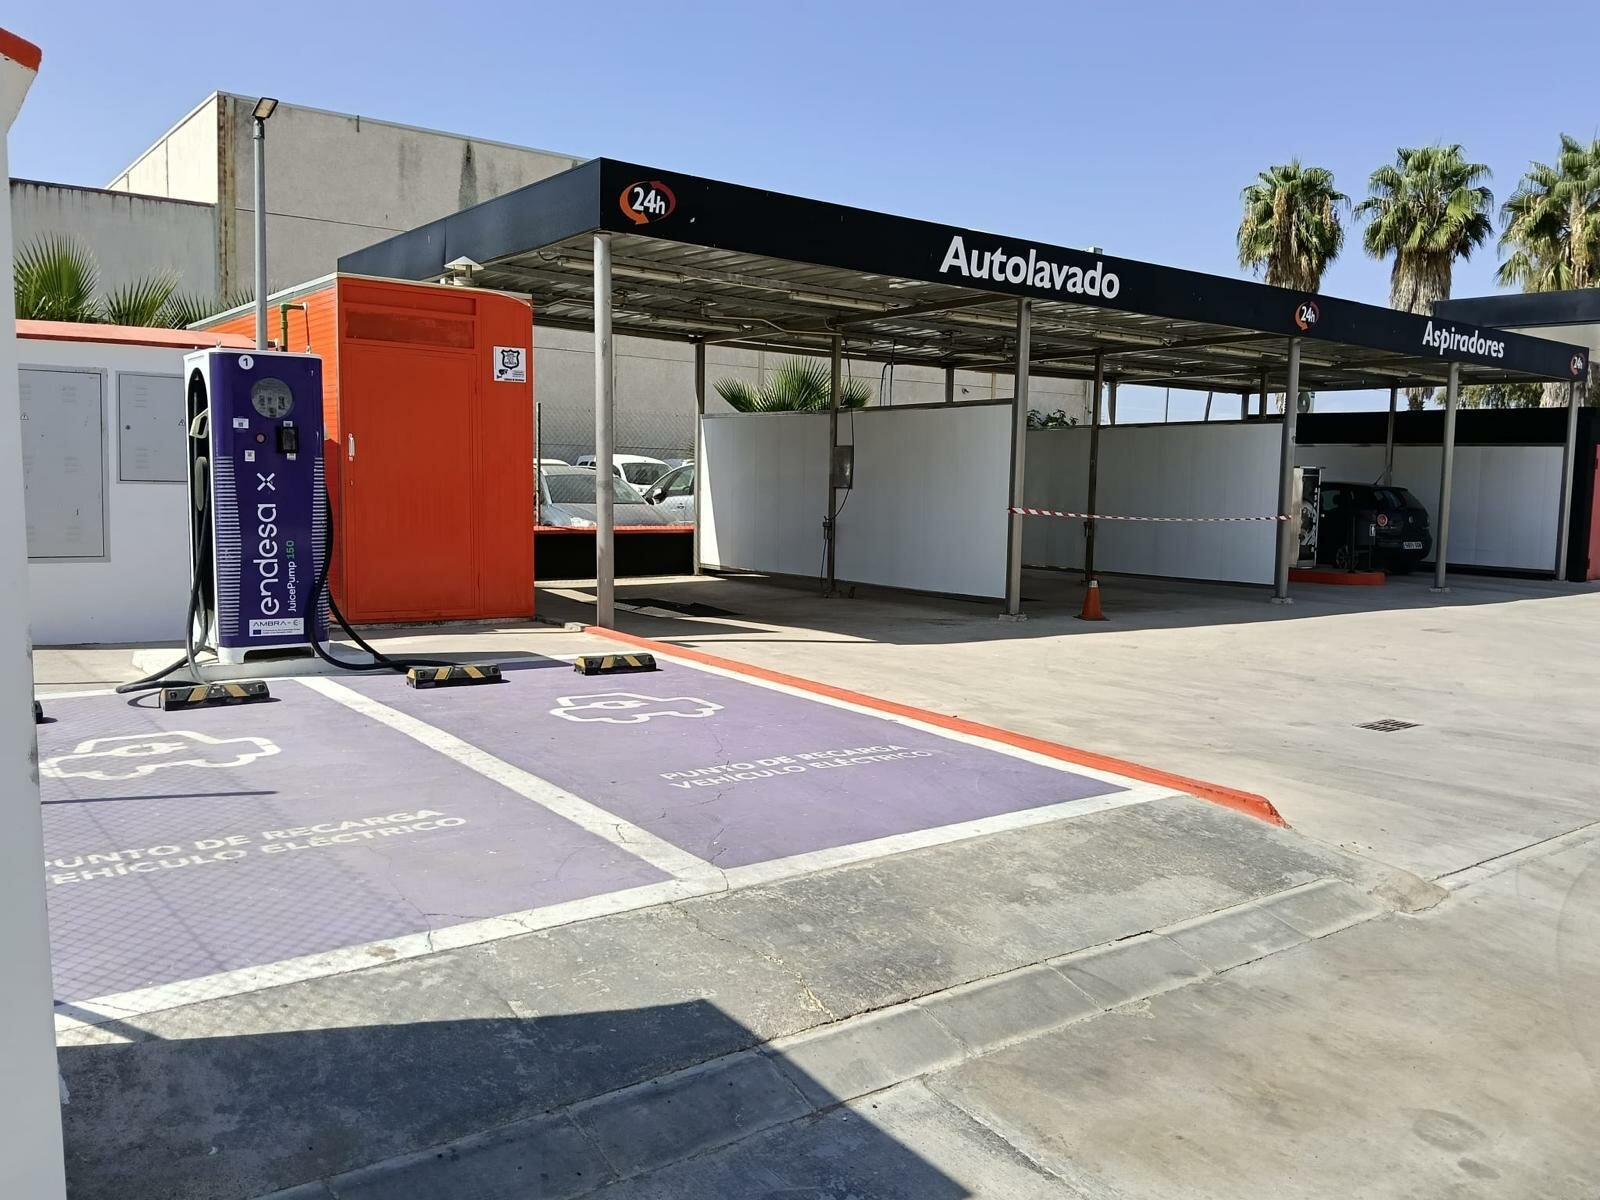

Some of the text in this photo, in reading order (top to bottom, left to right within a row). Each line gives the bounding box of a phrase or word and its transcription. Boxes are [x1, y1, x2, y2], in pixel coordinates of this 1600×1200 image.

[631, 186, 666, 215] 24h
[938, 235, 1120, 299] Autolavado
[1300, 305, 1316, 323] 24h
[1421, 320, 1505, 358] Aspiradores
[253, 503, 280, 616] endesa
[285, 540, 298, 613] JuicePump 150
[659, 744, 909, 780] PUNTO DE RECARGA
[194, 834, 252, 850] DE
[261, 809, 446, 841] RECARGA
